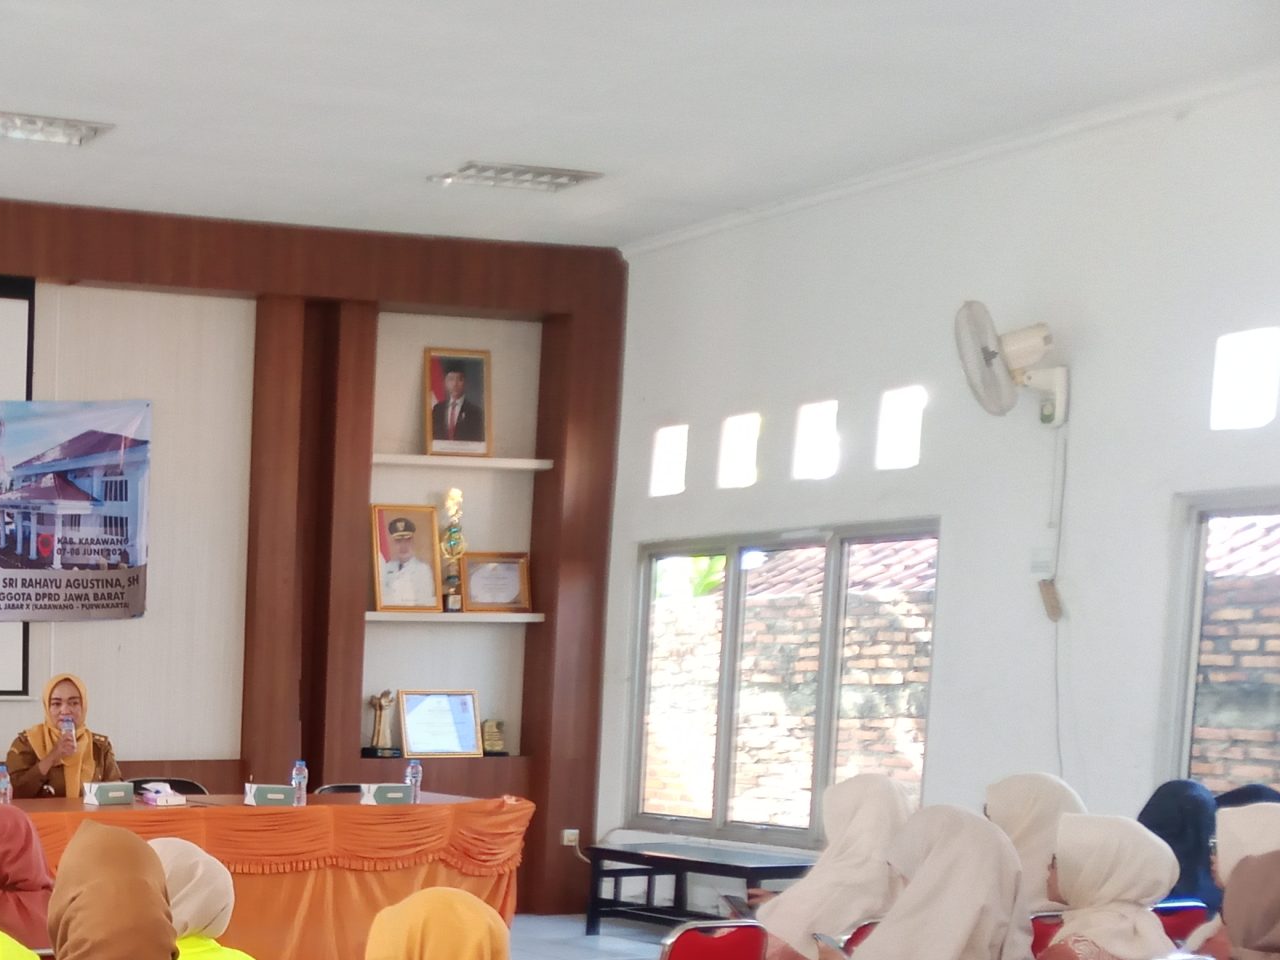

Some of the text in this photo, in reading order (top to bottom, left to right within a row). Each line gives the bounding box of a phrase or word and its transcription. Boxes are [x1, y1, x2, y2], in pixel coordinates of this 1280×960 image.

[79, 537, 129, 545] KARAWANG
[2, 577, 18, 588] SRI
[21, 577, 62, 589] RAHAYU
[65, 577, 125, 590] AGUSTINA,
[128, 575, 139, 587] SH
[35, 592, 60, 602] DPRD
[63, 592, 90, 602] JAWA
[93, 592, 126, 602] BARAT
